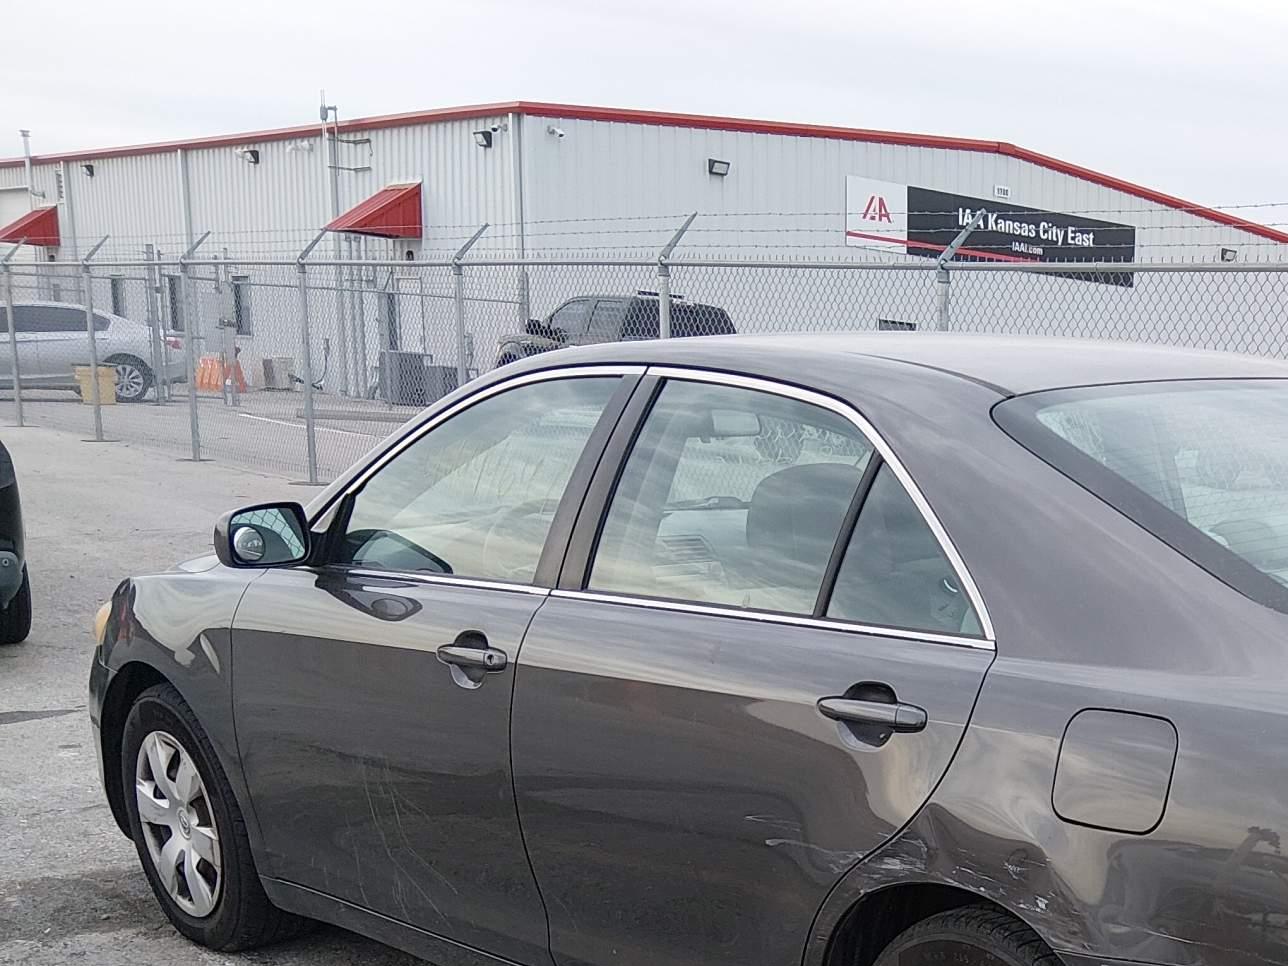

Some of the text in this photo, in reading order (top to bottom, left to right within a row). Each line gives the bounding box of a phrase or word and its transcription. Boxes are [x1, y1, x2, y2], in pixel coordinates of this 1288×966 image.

[988, 212, 1036, 238] Kansas
[1039, 221, 1065, 246] City
[1067, 226, 1095, 247] East
